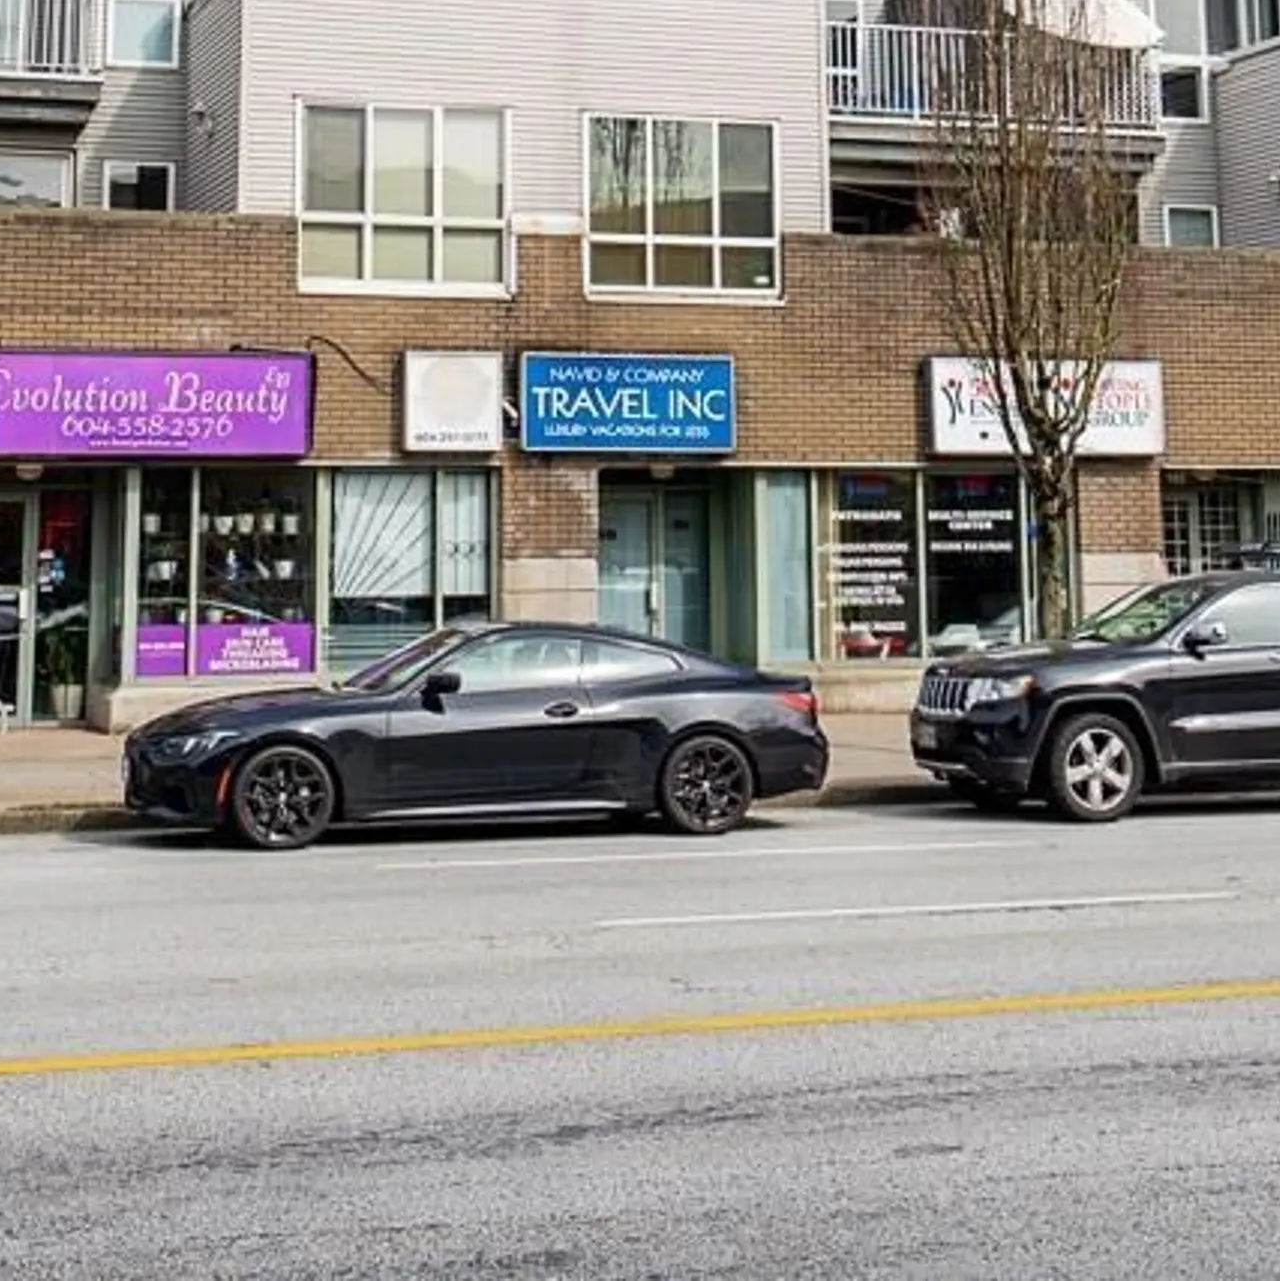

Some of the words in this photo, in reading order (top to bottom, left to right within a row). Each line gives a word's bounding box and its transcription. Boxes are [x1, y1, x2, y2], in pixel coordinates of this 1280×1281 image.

[624, 367, 705, 384] COMPANY
[159, 371, 288, 424] Beauty
[532, 387, 659, 419] TRAVEL
[669, 389, 726, 421] INC
